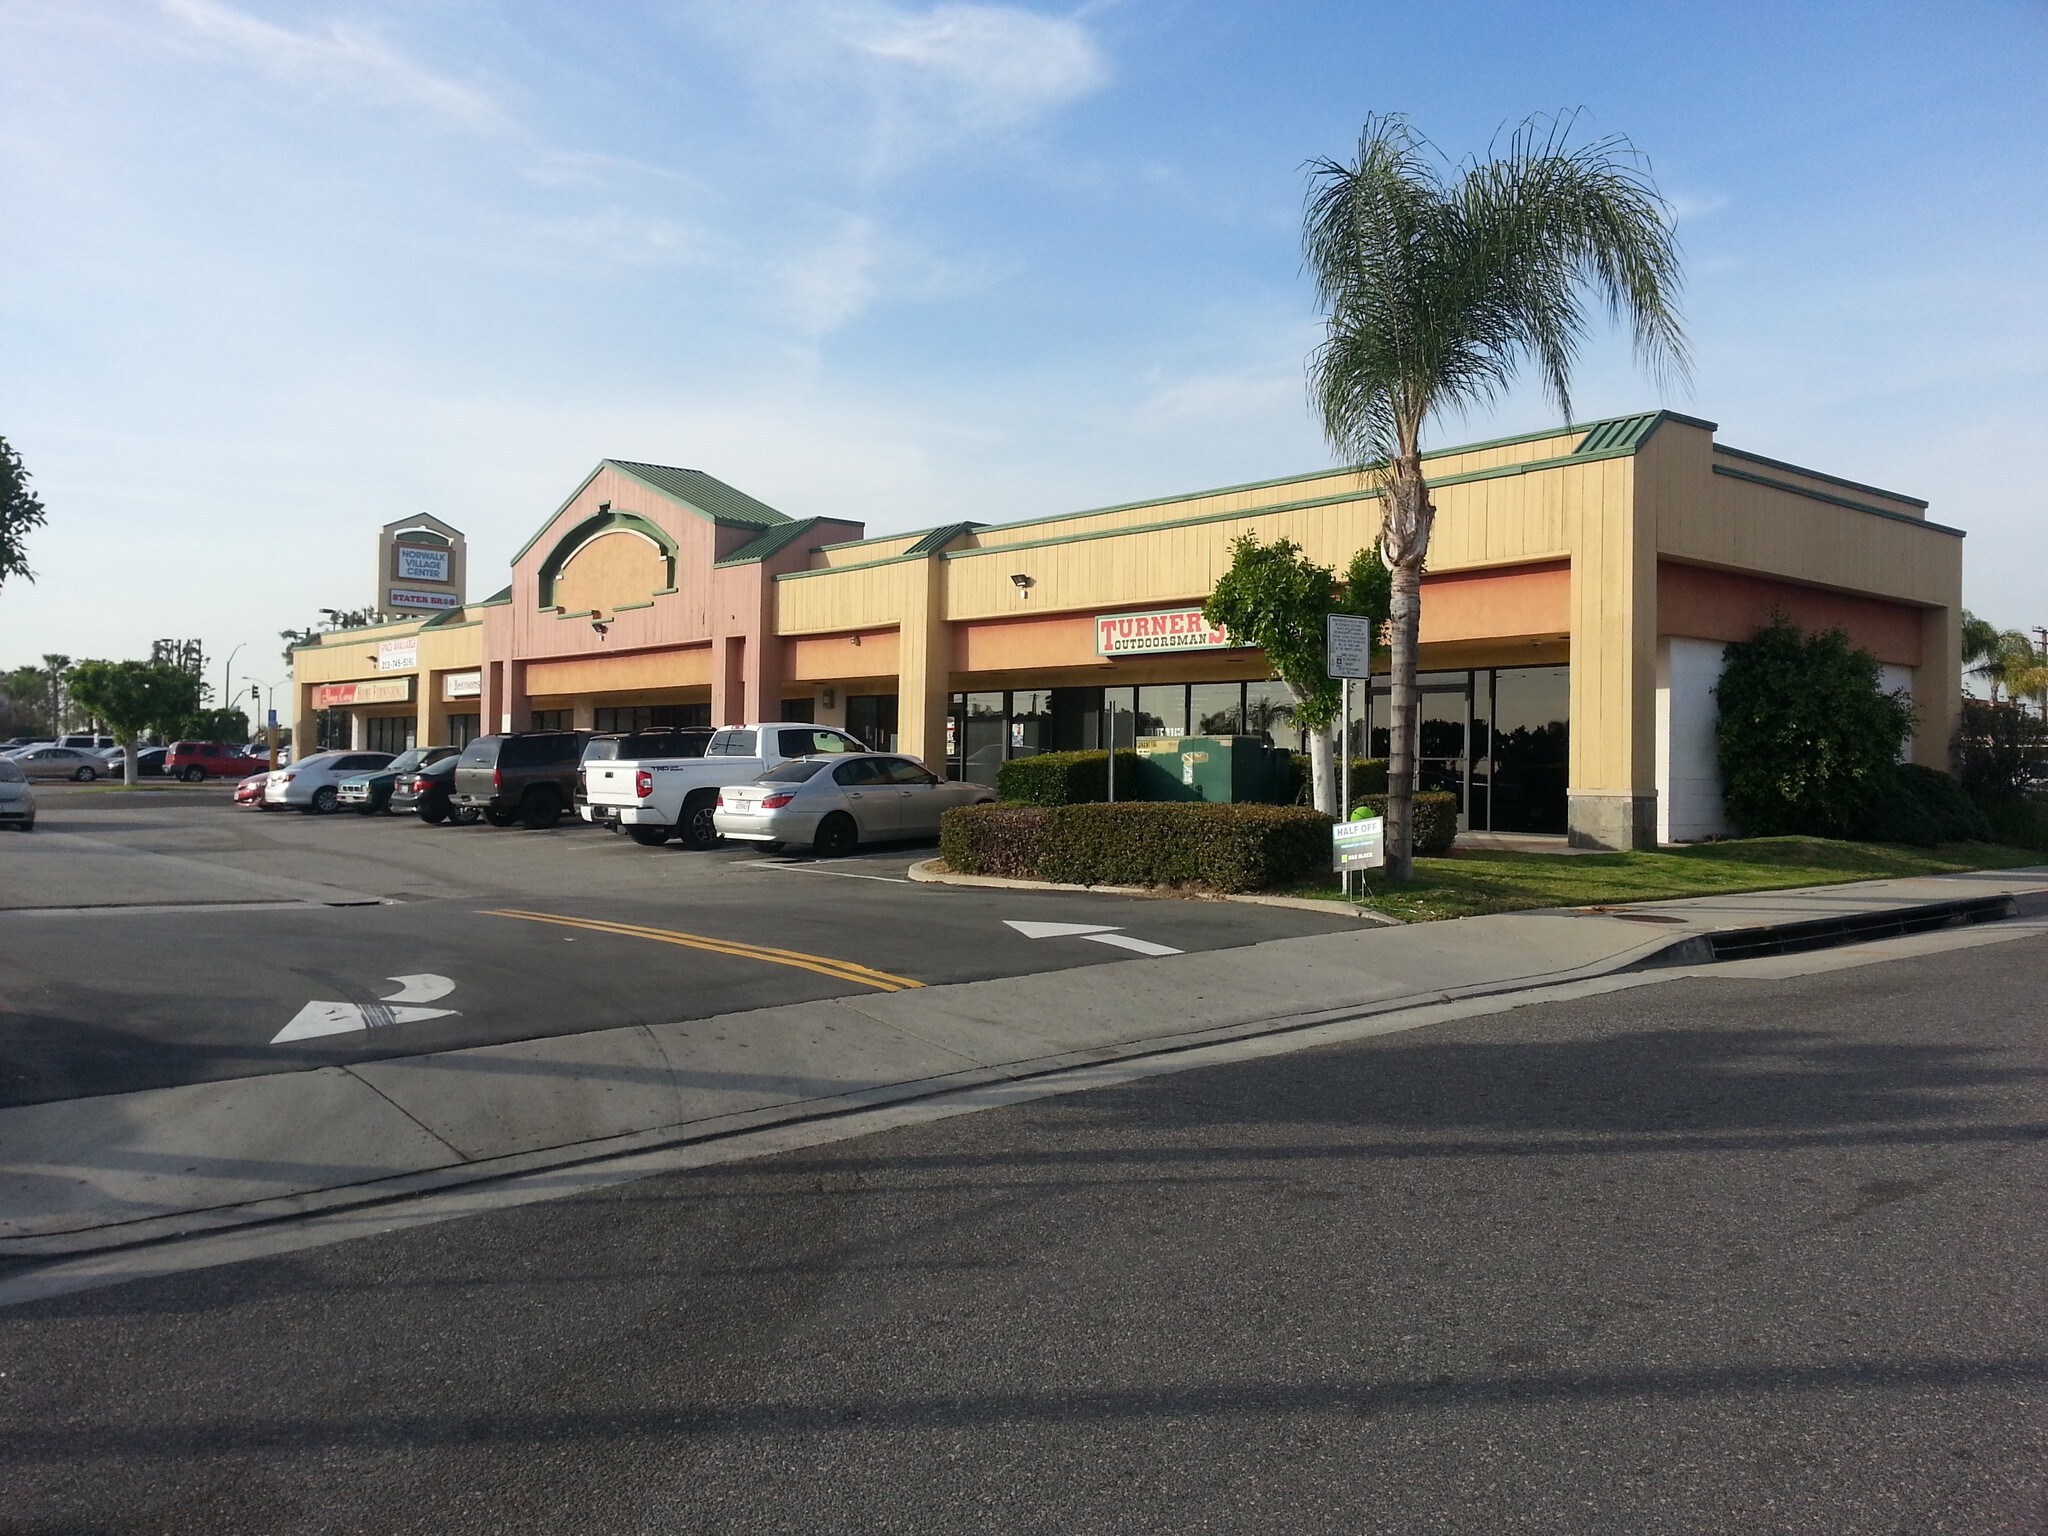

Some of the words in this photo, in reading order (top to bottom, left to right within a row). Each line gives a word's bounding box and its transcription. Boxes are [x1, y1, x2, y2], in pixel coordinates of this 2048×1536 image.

[402, 550, 446, 561] NORWALK
[406, 558, 441, 569] VILLAGE
[407, 567, 440, 578] CENTER
[392, 594, 429, 604] STATER
[1101, 612, 1226, 651] TURNERS
[1114, 633, 1207, 650] OUTDOORSMAN
[1337, 826, 1359, 837] HALF
[1360, 823, 1377, 833] OFF
